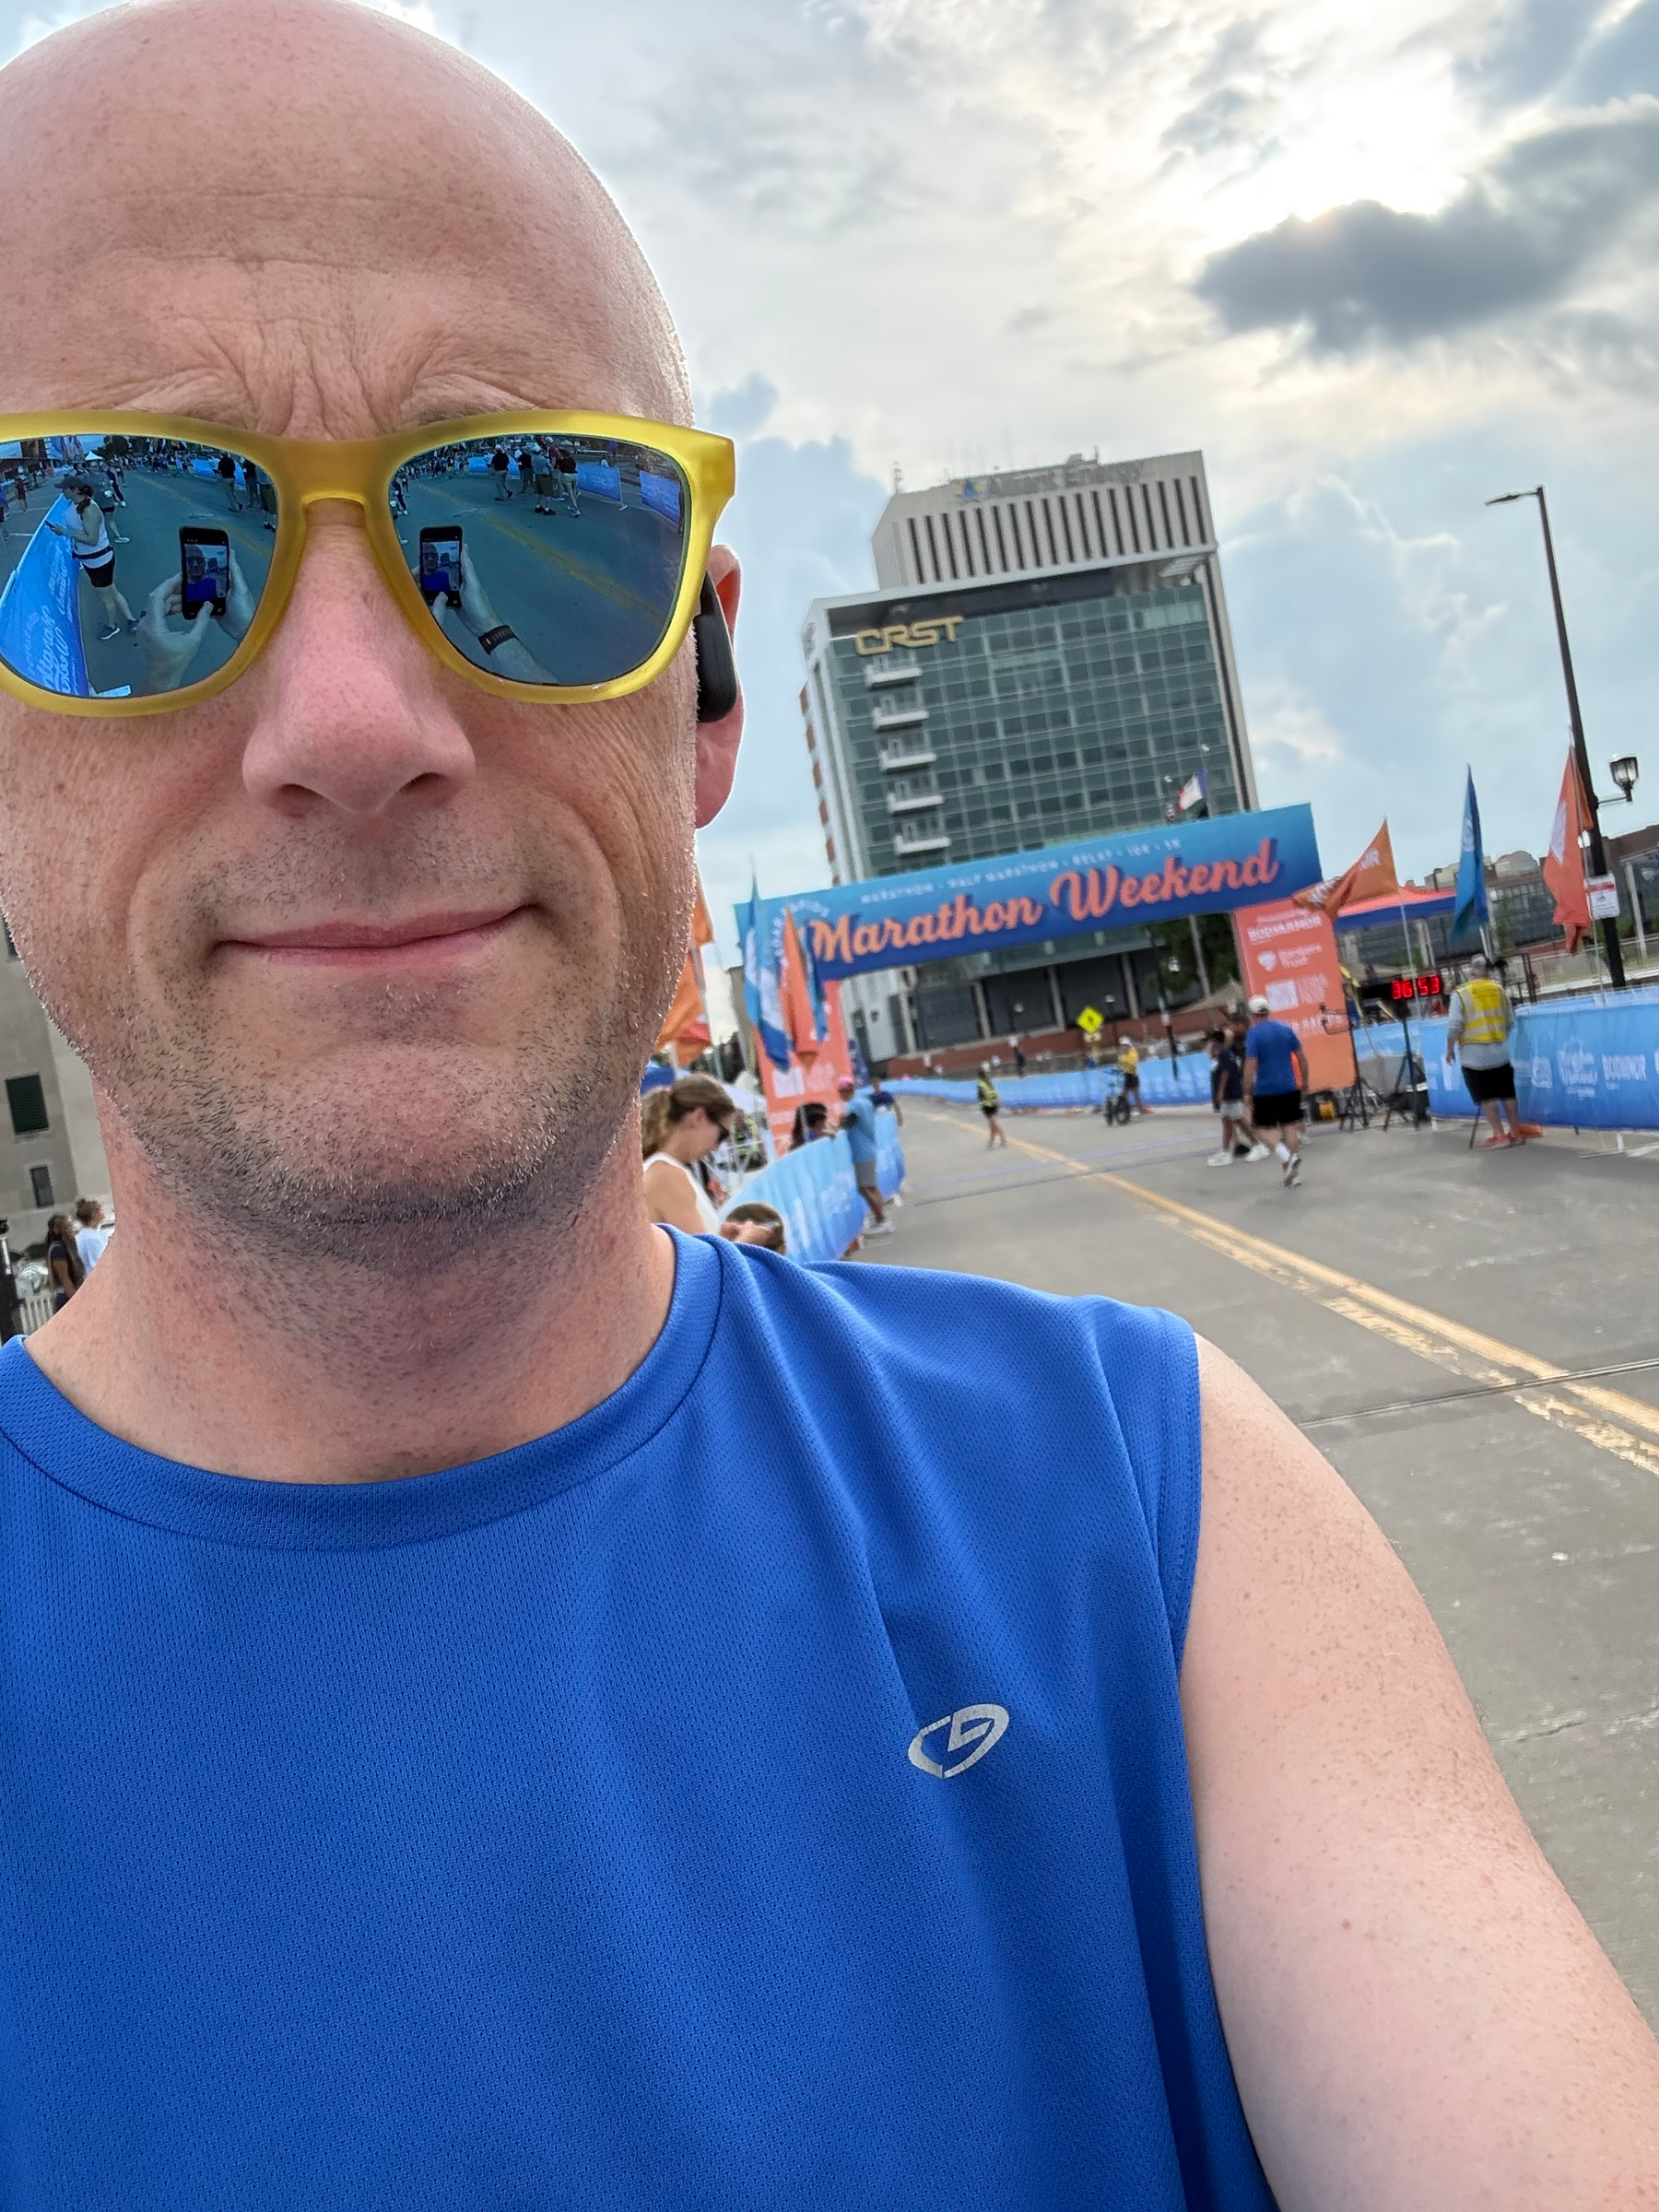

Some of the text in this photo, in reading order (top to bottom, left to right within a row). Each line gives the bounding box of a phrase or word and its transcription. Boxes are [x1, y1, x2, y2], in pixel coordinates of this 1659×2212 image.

[856, 615, 965, 655] CRST
[800, 894, 1043, 964] Marathon
[1048, 837, 1280, 922] Weekend
[1392, 974, 1441, 1000] 3653
